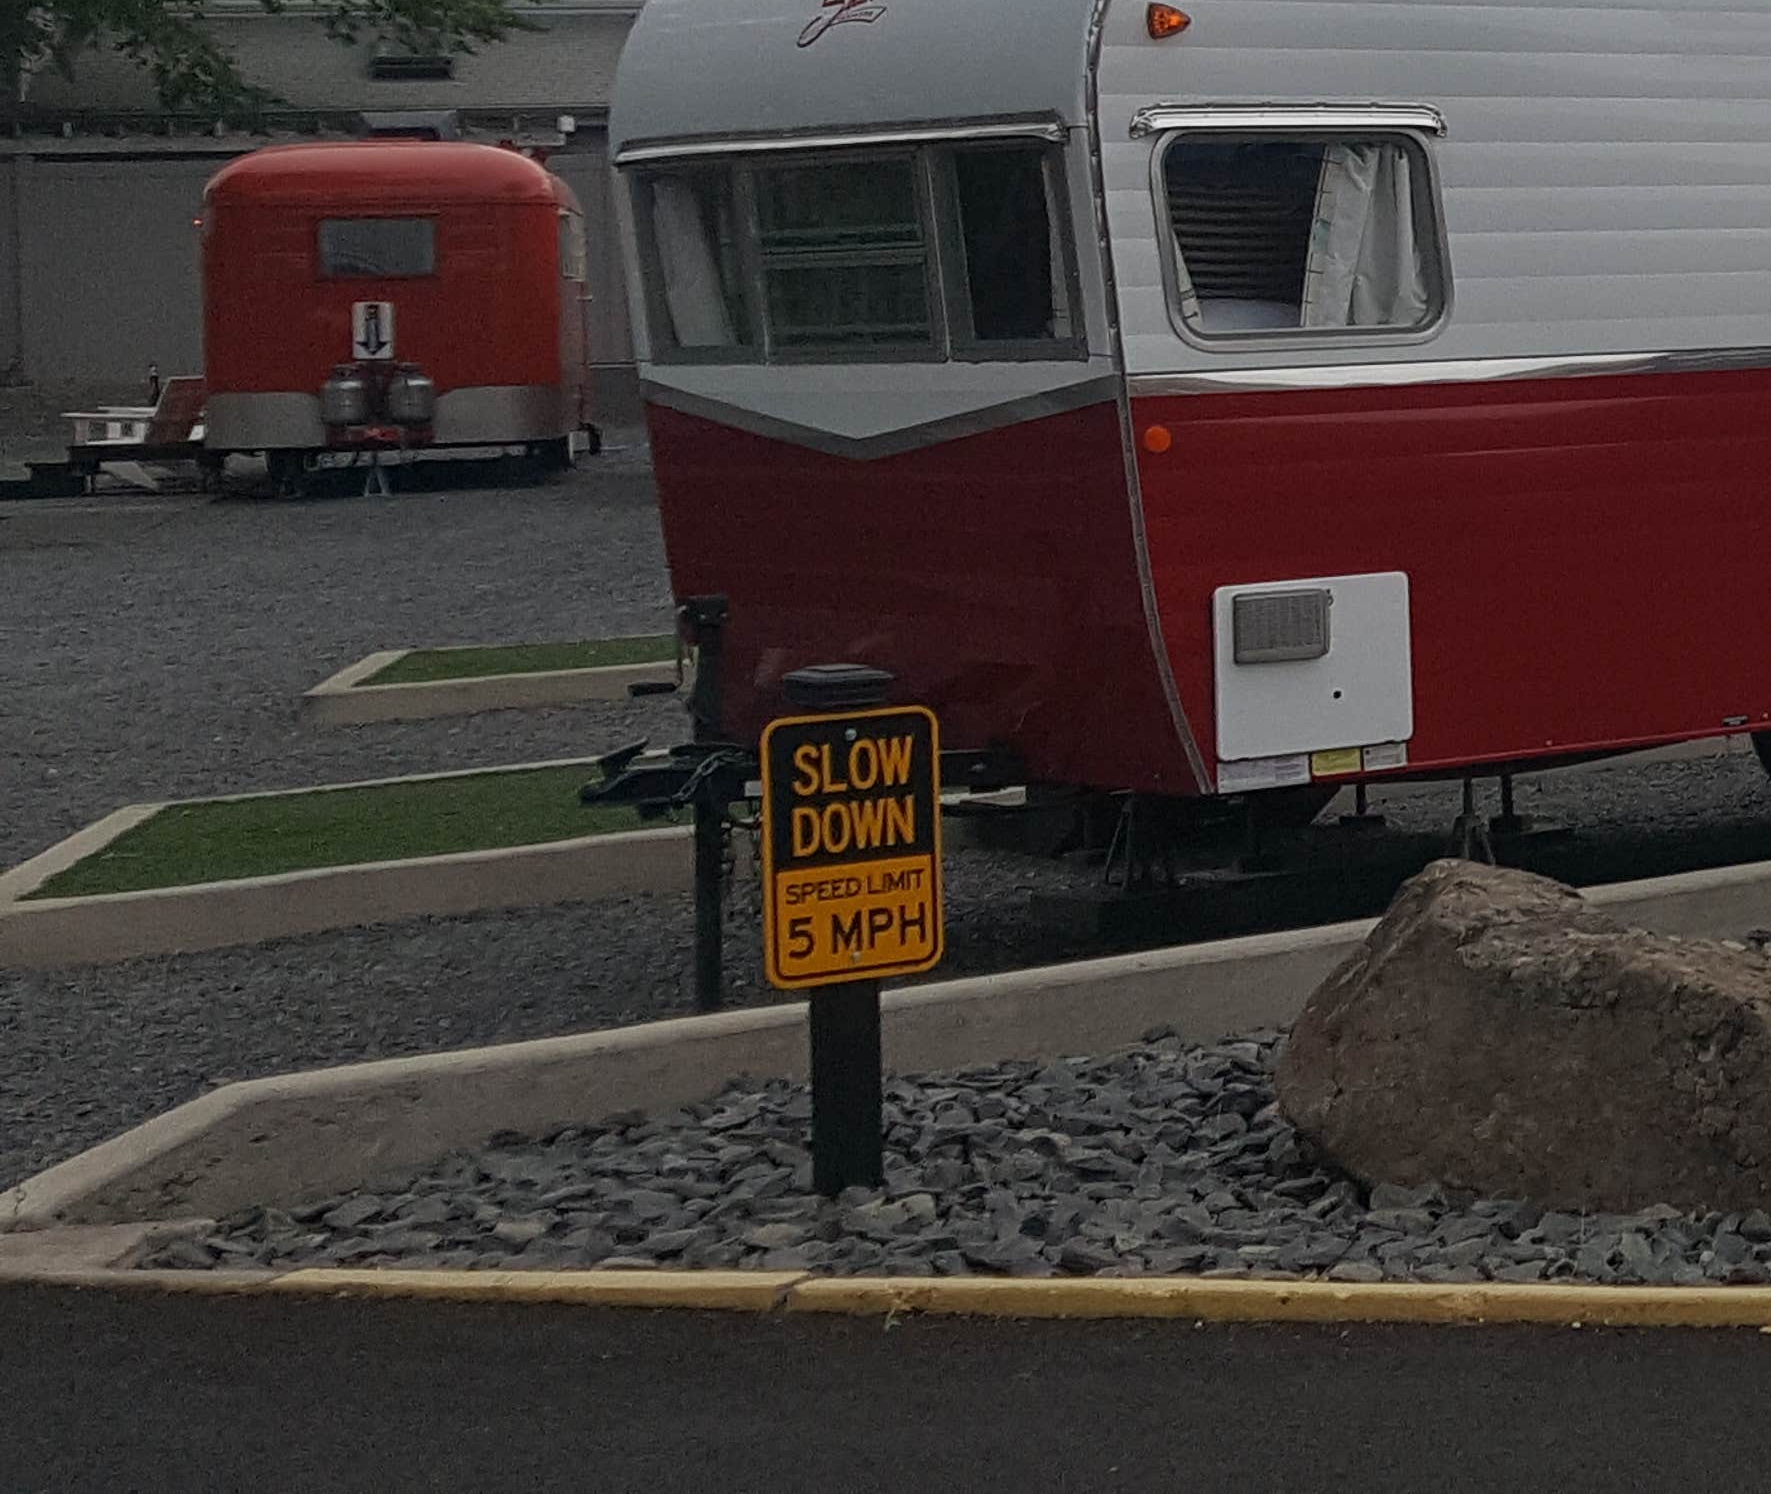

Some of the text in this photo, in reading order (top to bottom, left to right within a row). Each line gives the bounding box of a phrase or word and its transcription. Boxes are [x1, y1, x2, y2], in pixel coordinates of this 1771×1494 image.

[793, 735, 913, 796] SLOW
[791, 794, 915, 857] DOWN
[786, 868, 925, 905] SPEED LIMIT
[788, 902, 926, 959] 5 MPH
